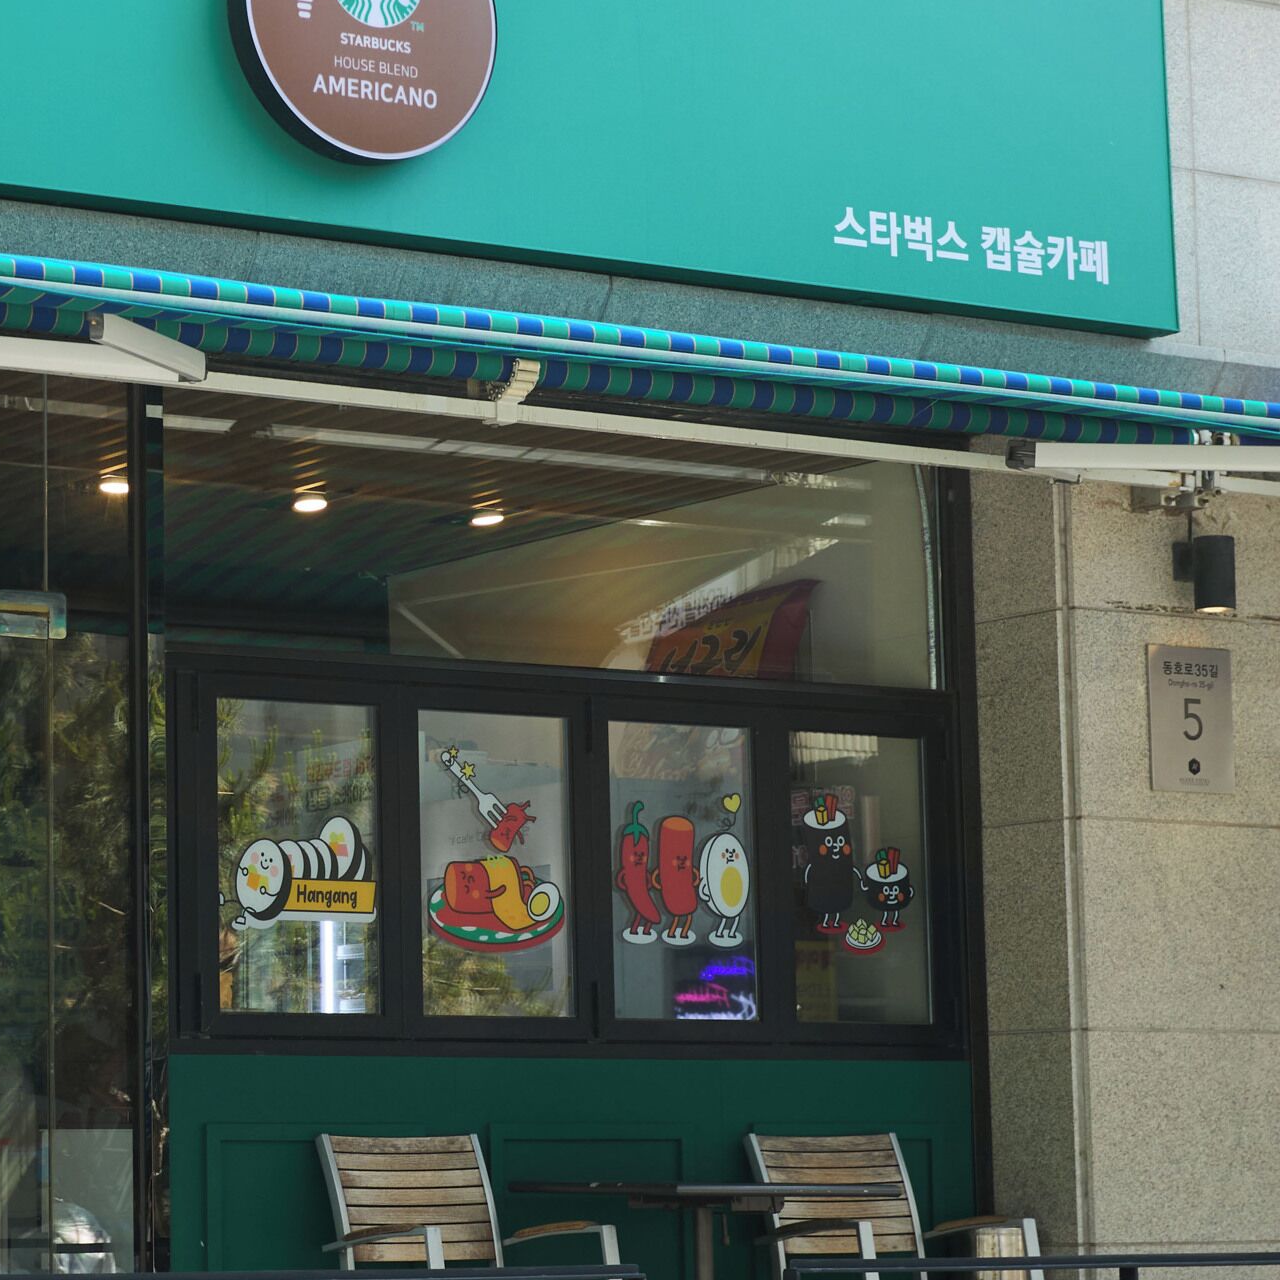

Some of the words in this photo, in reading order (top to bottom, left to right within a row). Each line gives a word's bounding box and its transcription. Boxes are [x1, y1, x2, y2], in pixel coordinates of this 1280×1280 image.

[340, 32, 412, 54] STARBUCKS
[334, 55, 375, 73] HOUSE
[379, 62, 419, 78] BLEND
[313, 73, 438, 109] AMERICANO
[833, 206, 969, 262] 스타벅스
[980, 225, 1110, 285] 캡슐카페
[1162, 661, 1218, 678] 동호로35길
[1183, 698, 1203, 741] 5
[296, 884, 358, 909] Hangang
